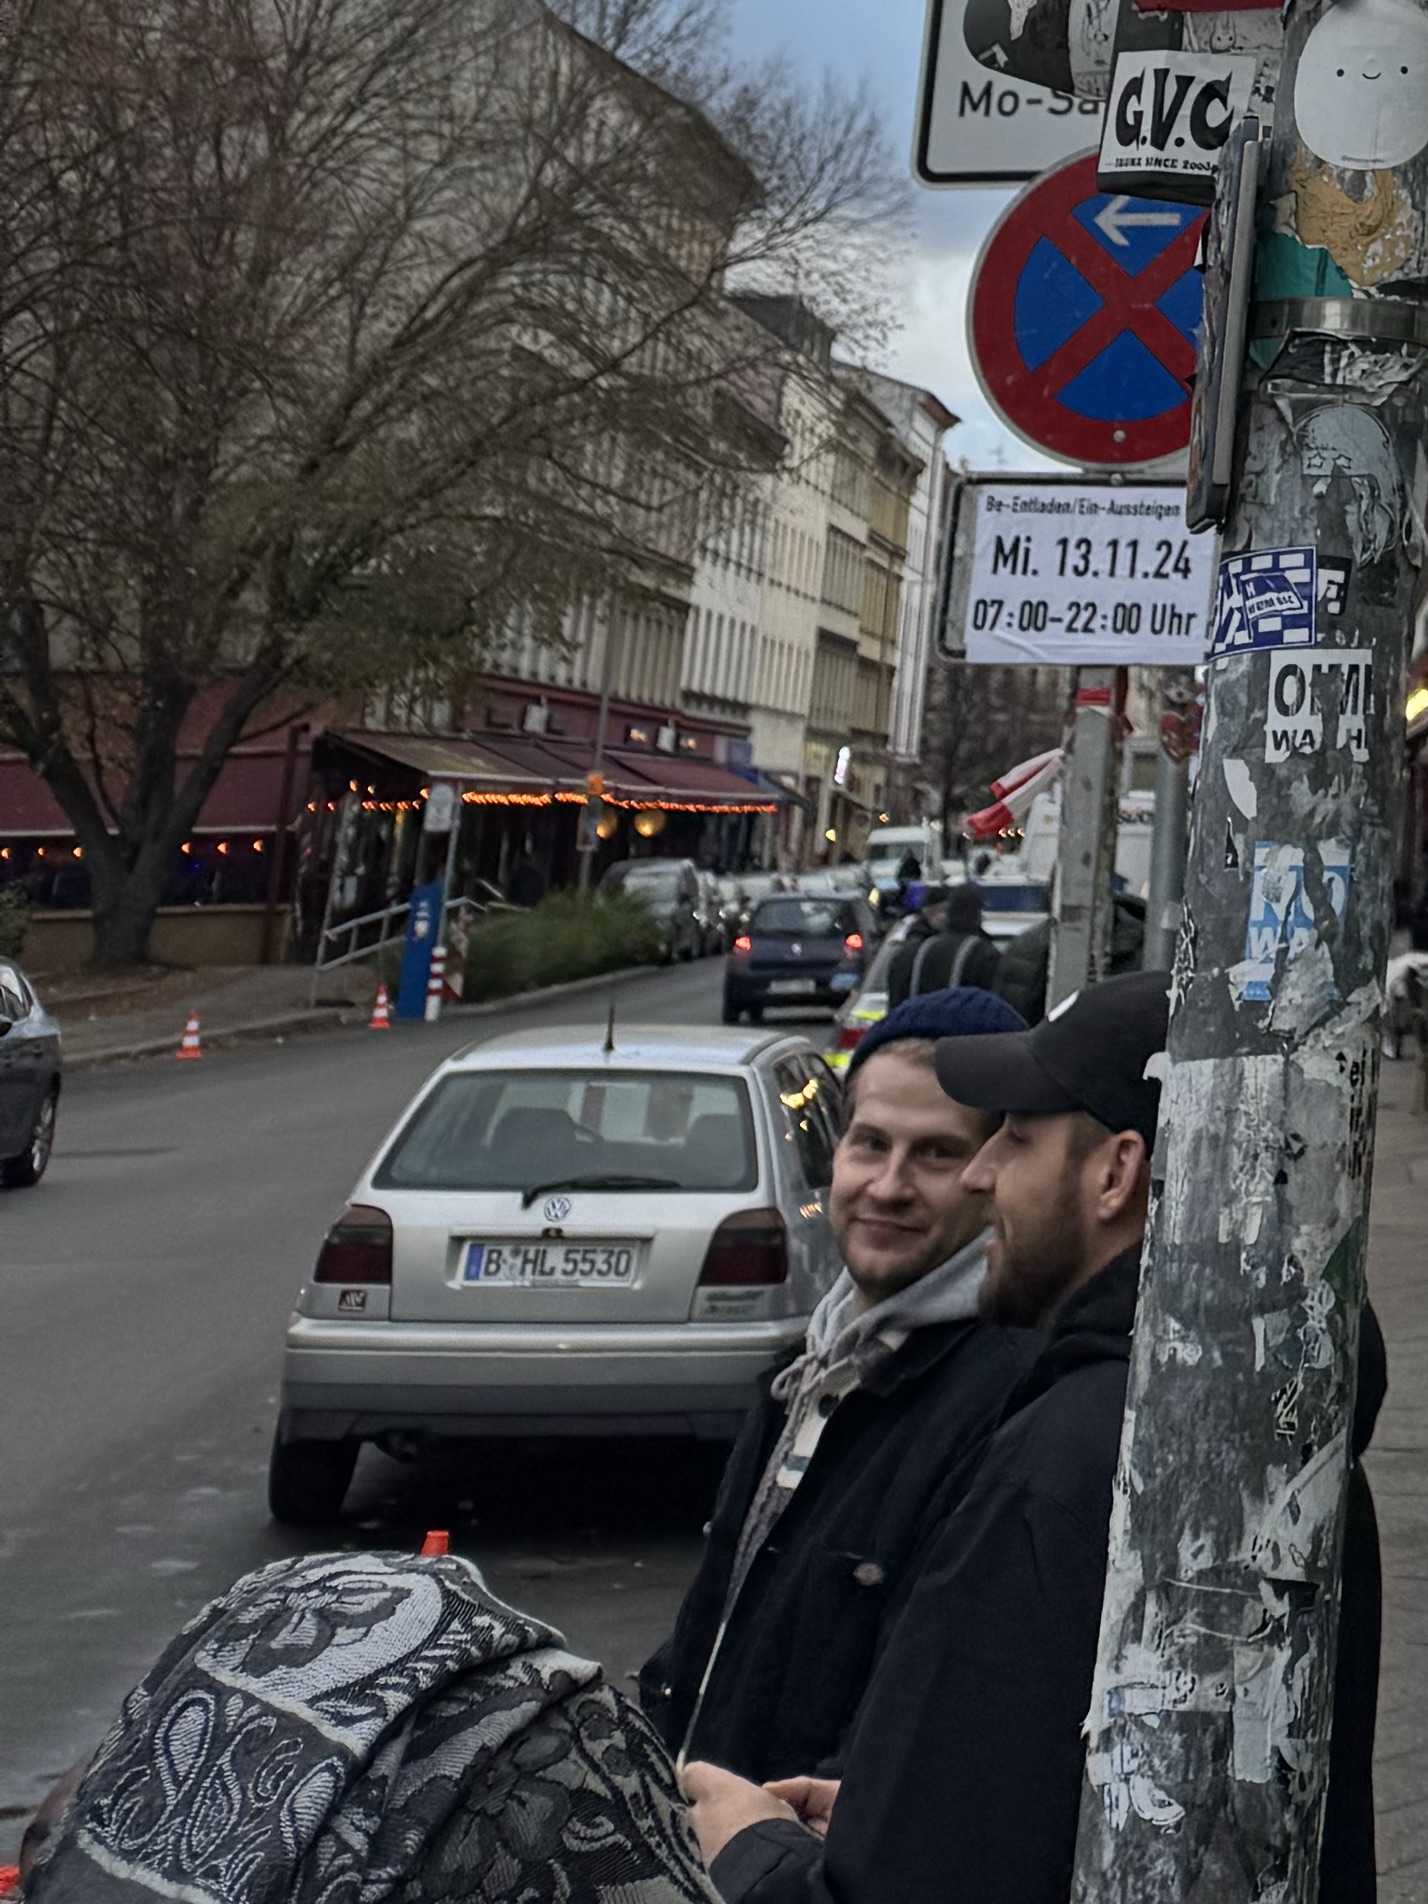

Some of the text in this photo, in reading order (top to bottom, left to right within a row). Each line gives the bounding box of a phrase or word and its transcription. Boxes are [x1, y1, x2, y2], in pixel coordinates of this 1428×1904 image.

[991, 535, 1192, 580] Mi. 13.11.24
[1150, 603, 1197, 637] Uhr
[483, 1249, 632, 1277] B HL 5530
